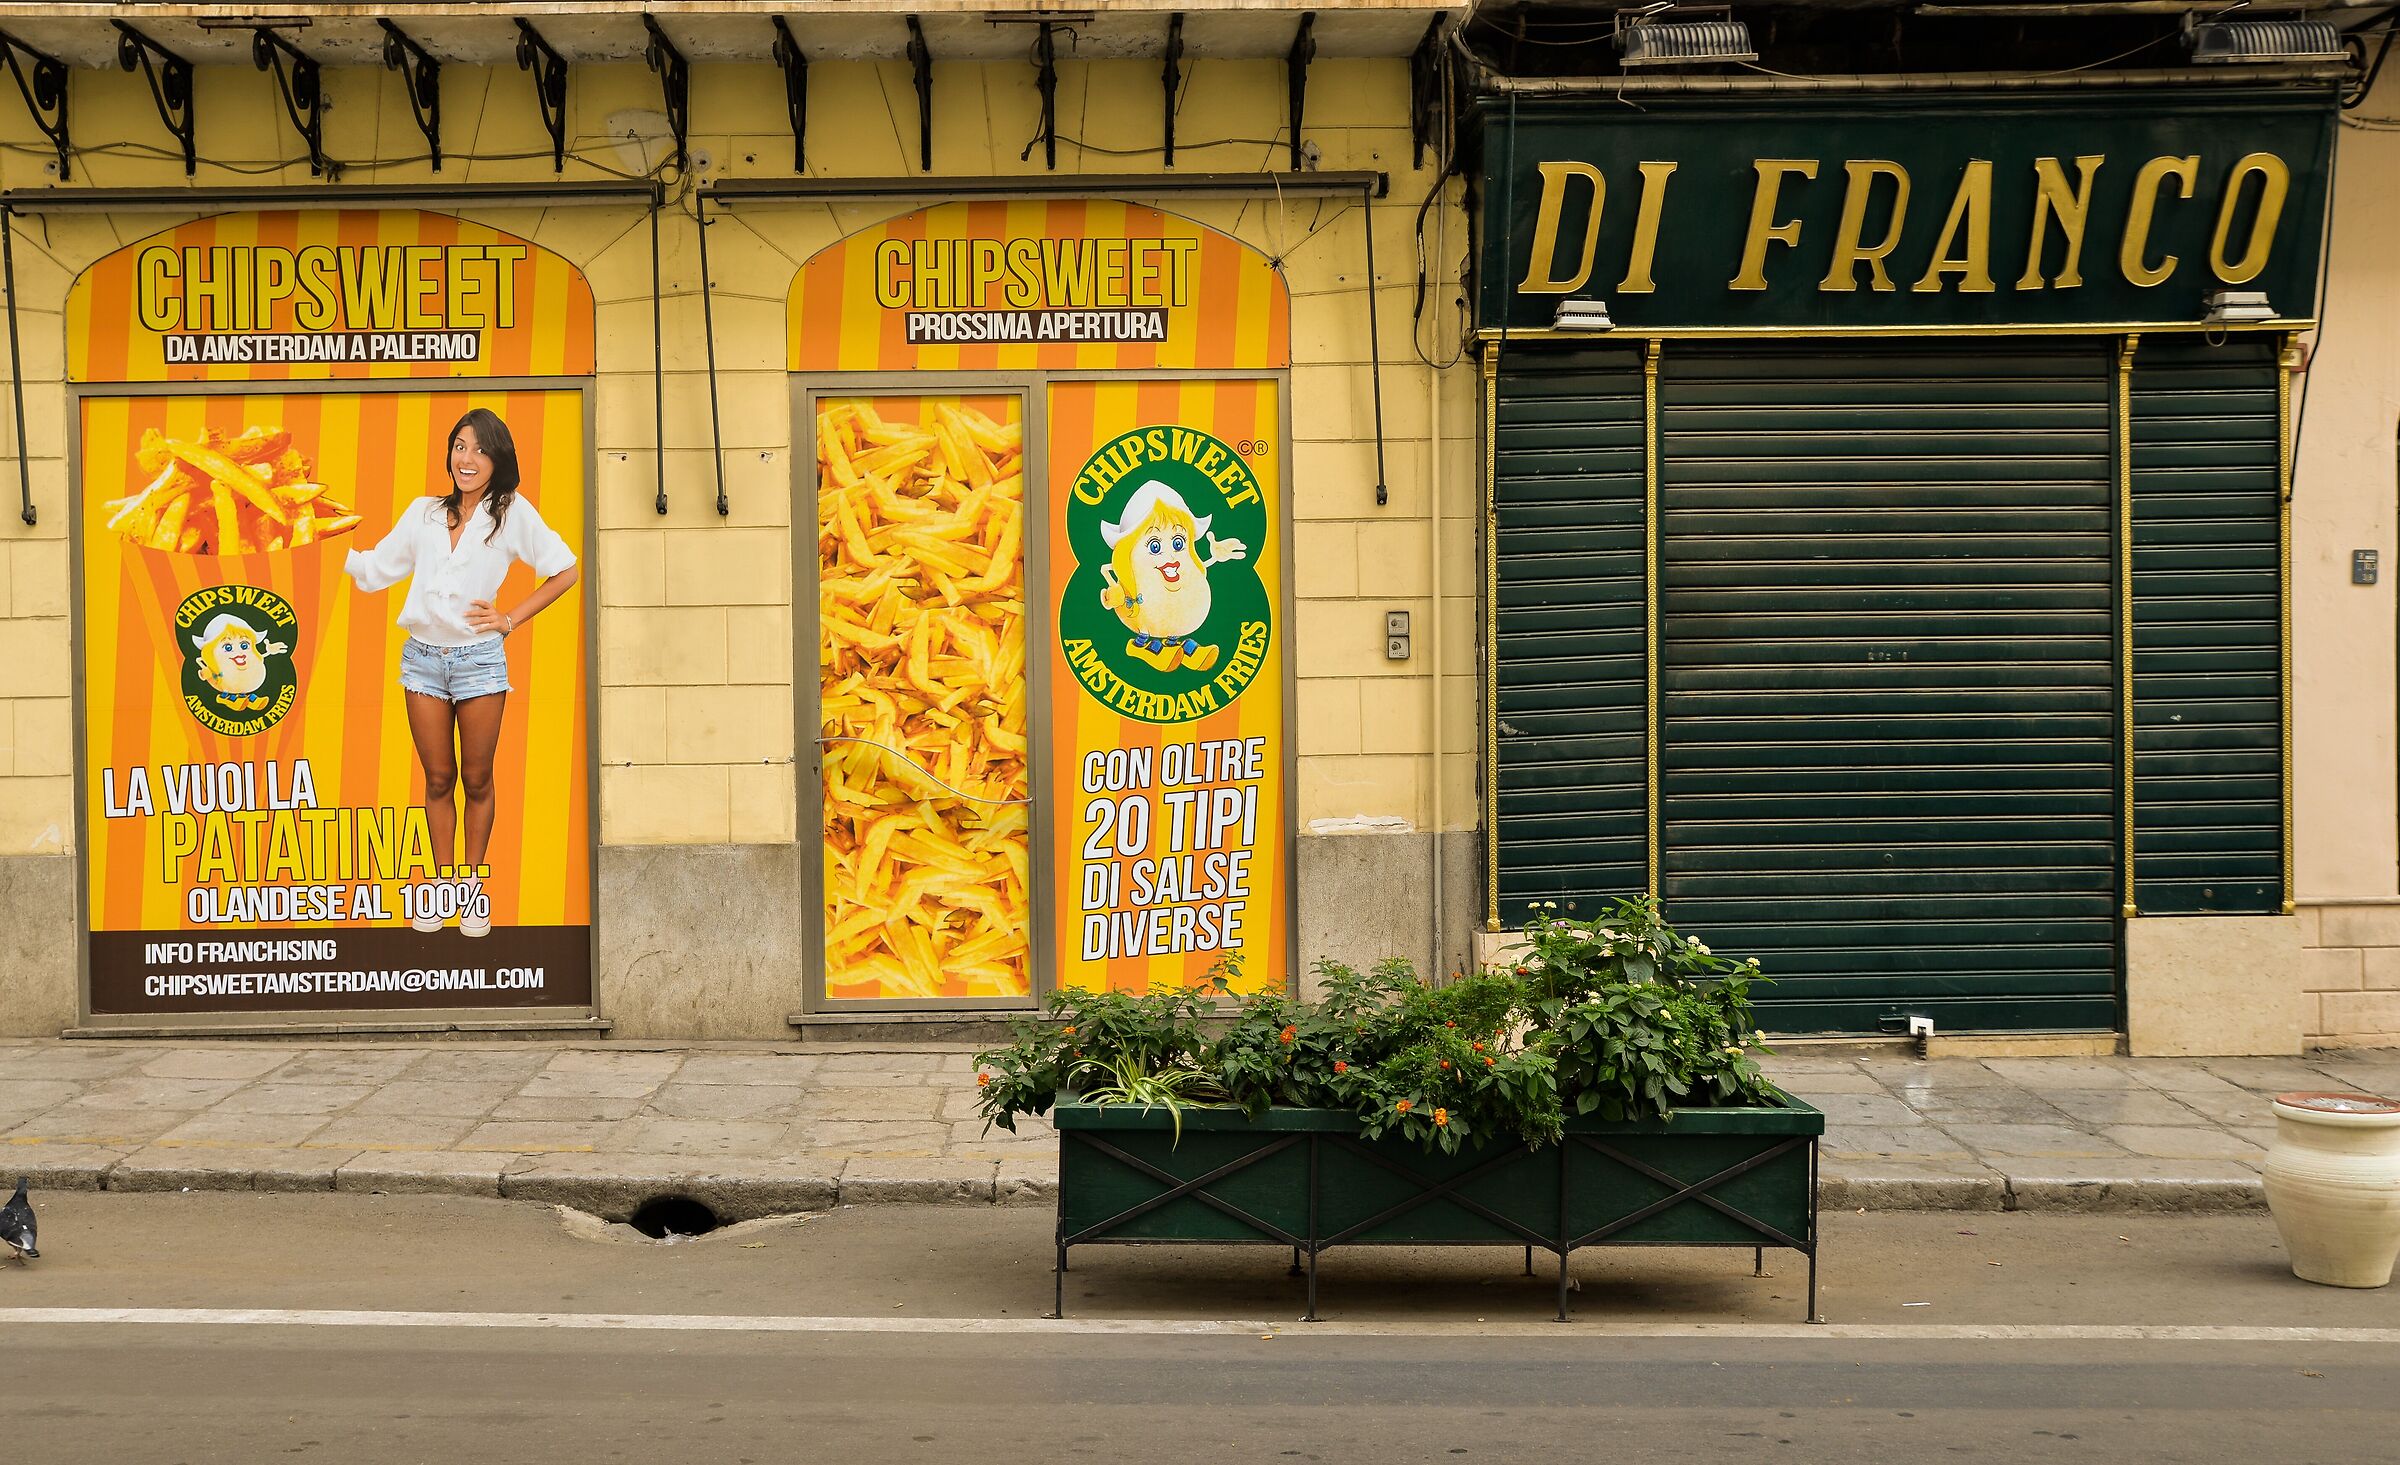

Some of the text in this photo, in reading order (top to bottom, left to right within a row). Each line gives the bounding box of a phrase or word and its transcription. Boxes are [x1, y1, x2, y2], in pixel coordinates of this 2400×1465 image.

[1517, 152, 2292, 294] DI FRANCO
[137, 245, 527, 332] CHIPSWEET
[874, 237, 1198, 310] CHIPSWEET
[166, 333, 476, 362] DA AMSTERDAM A PALERMO
[909, 312, 1164, 341] PROSSIMA APERTURA
[1074, 425, 1260, 509] CHIPSWEET
[175, 586, 296, 628] CHIPSWEET
[1064, 620, 1267, 721] AMSTERDAM FRIES
[185, 684, 296, 736] AMSTERDAM FRIES
[102, 758, 318, 818] LA VUOI LA
[1082, 736, 1266, 793] CON OLTRE
[161, 806, 491, 885] PATATINA...
[1082, 786, 1259, 860] 20 TIPI
[187, 882, 491, 924] OLANDESE AL 100%
[1082, 850, 1252, 911] DI SALSE
[145, 939, 337, 965] INFO FRANCHISING
[1081, 901, 1245, 961] DIVERSE
[144, 967, 545, 998] CHIPSWEETAMSTERDAM@GMAIL.COM
